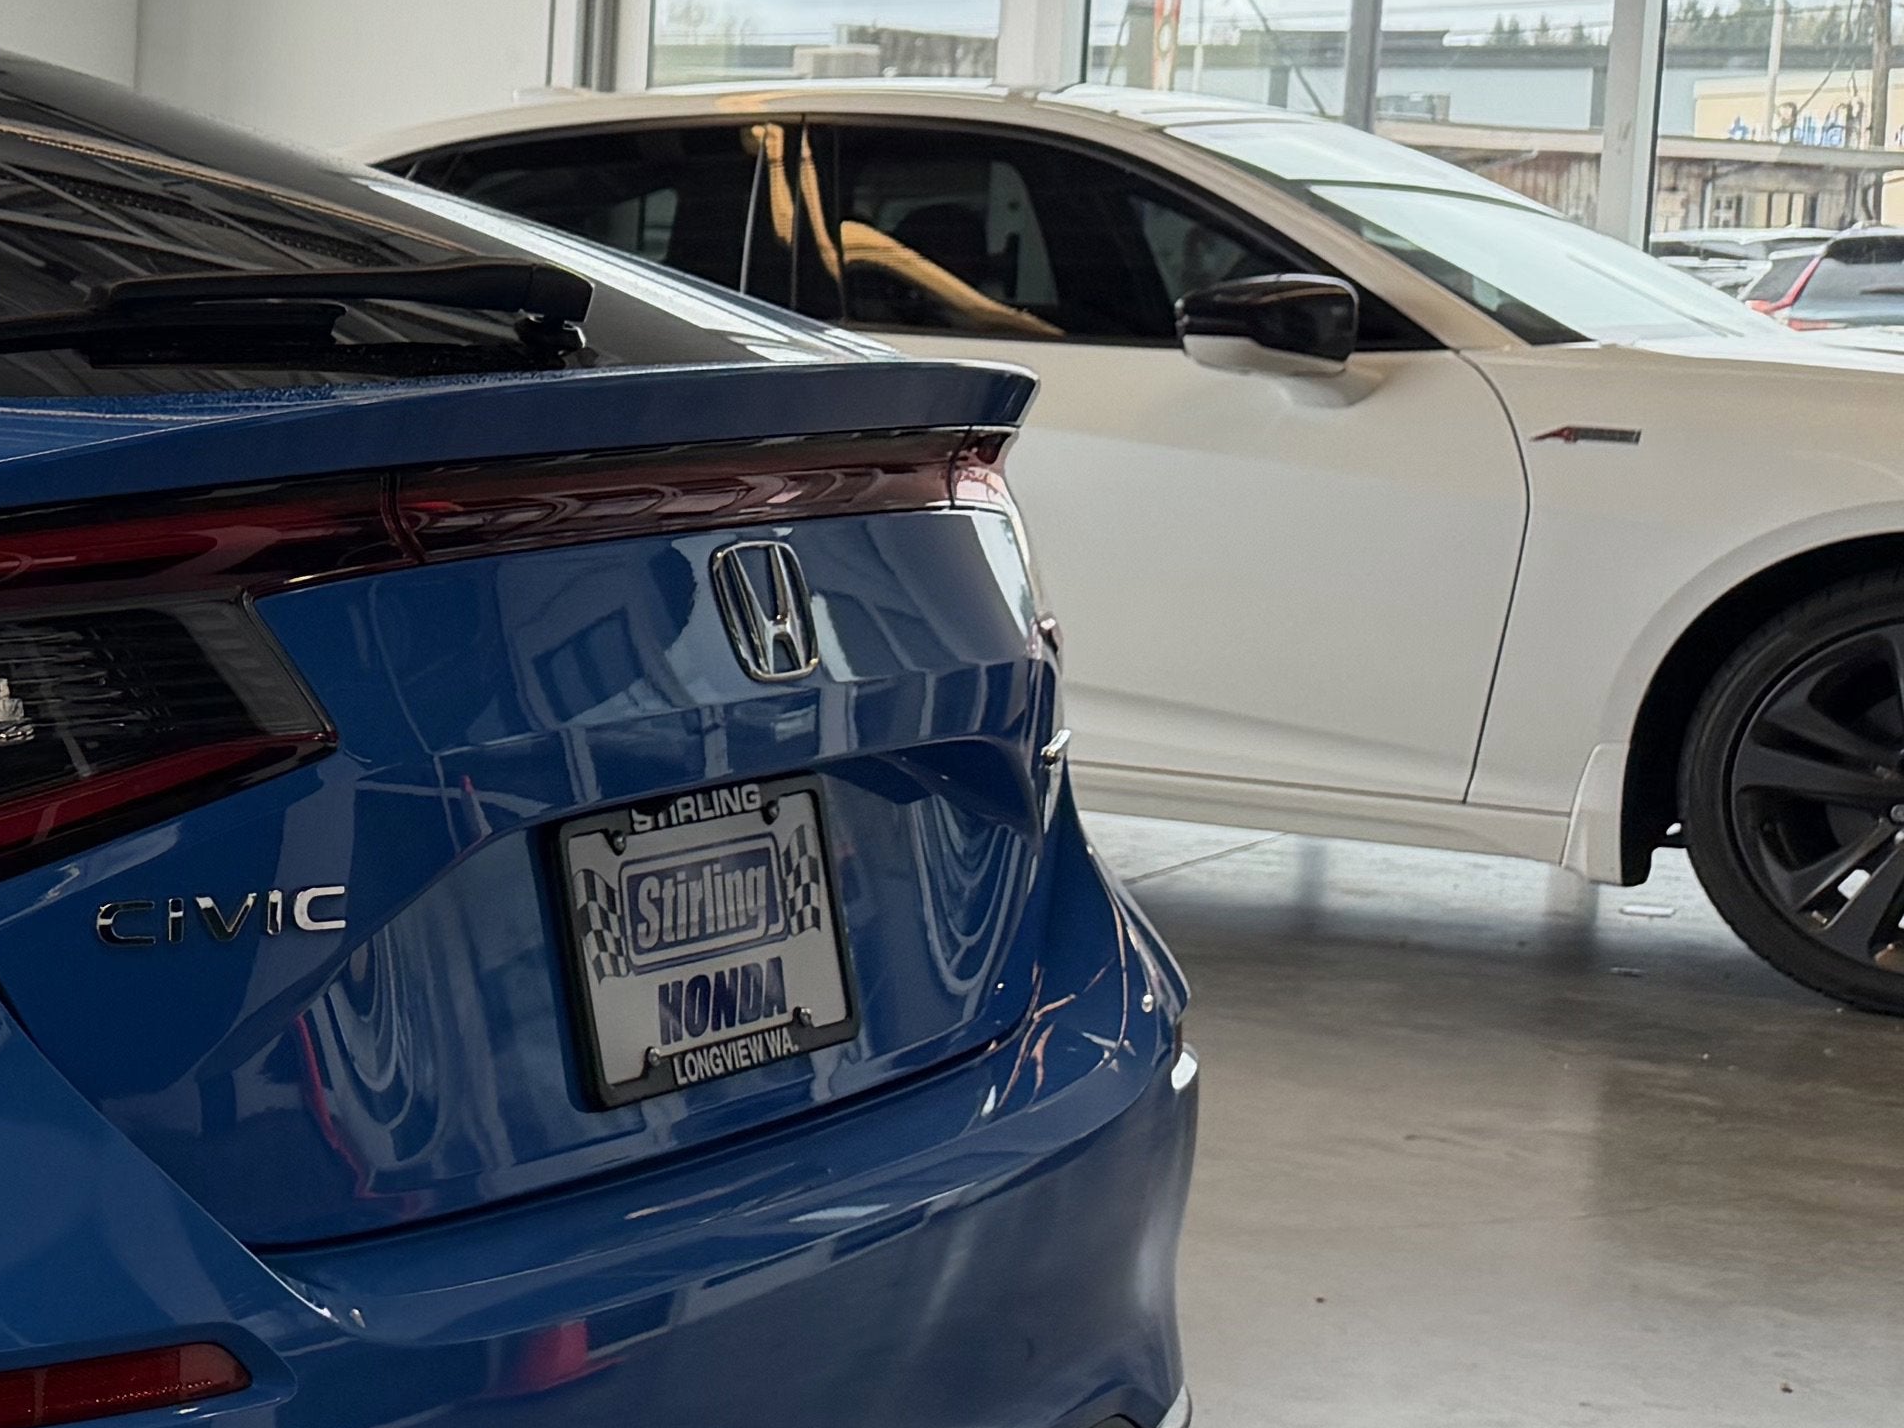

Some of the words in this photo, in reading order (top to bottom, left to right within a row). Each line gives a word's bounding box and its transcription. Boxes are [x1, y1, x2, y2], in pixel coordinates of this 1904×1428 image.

[96, 885, 347, 948] CIVIC
[636, 862, 768, 950] Stirling
[657, 956, 787, 1046] HONDA
[672, 1033, 766, 1087] LONGVIEW
